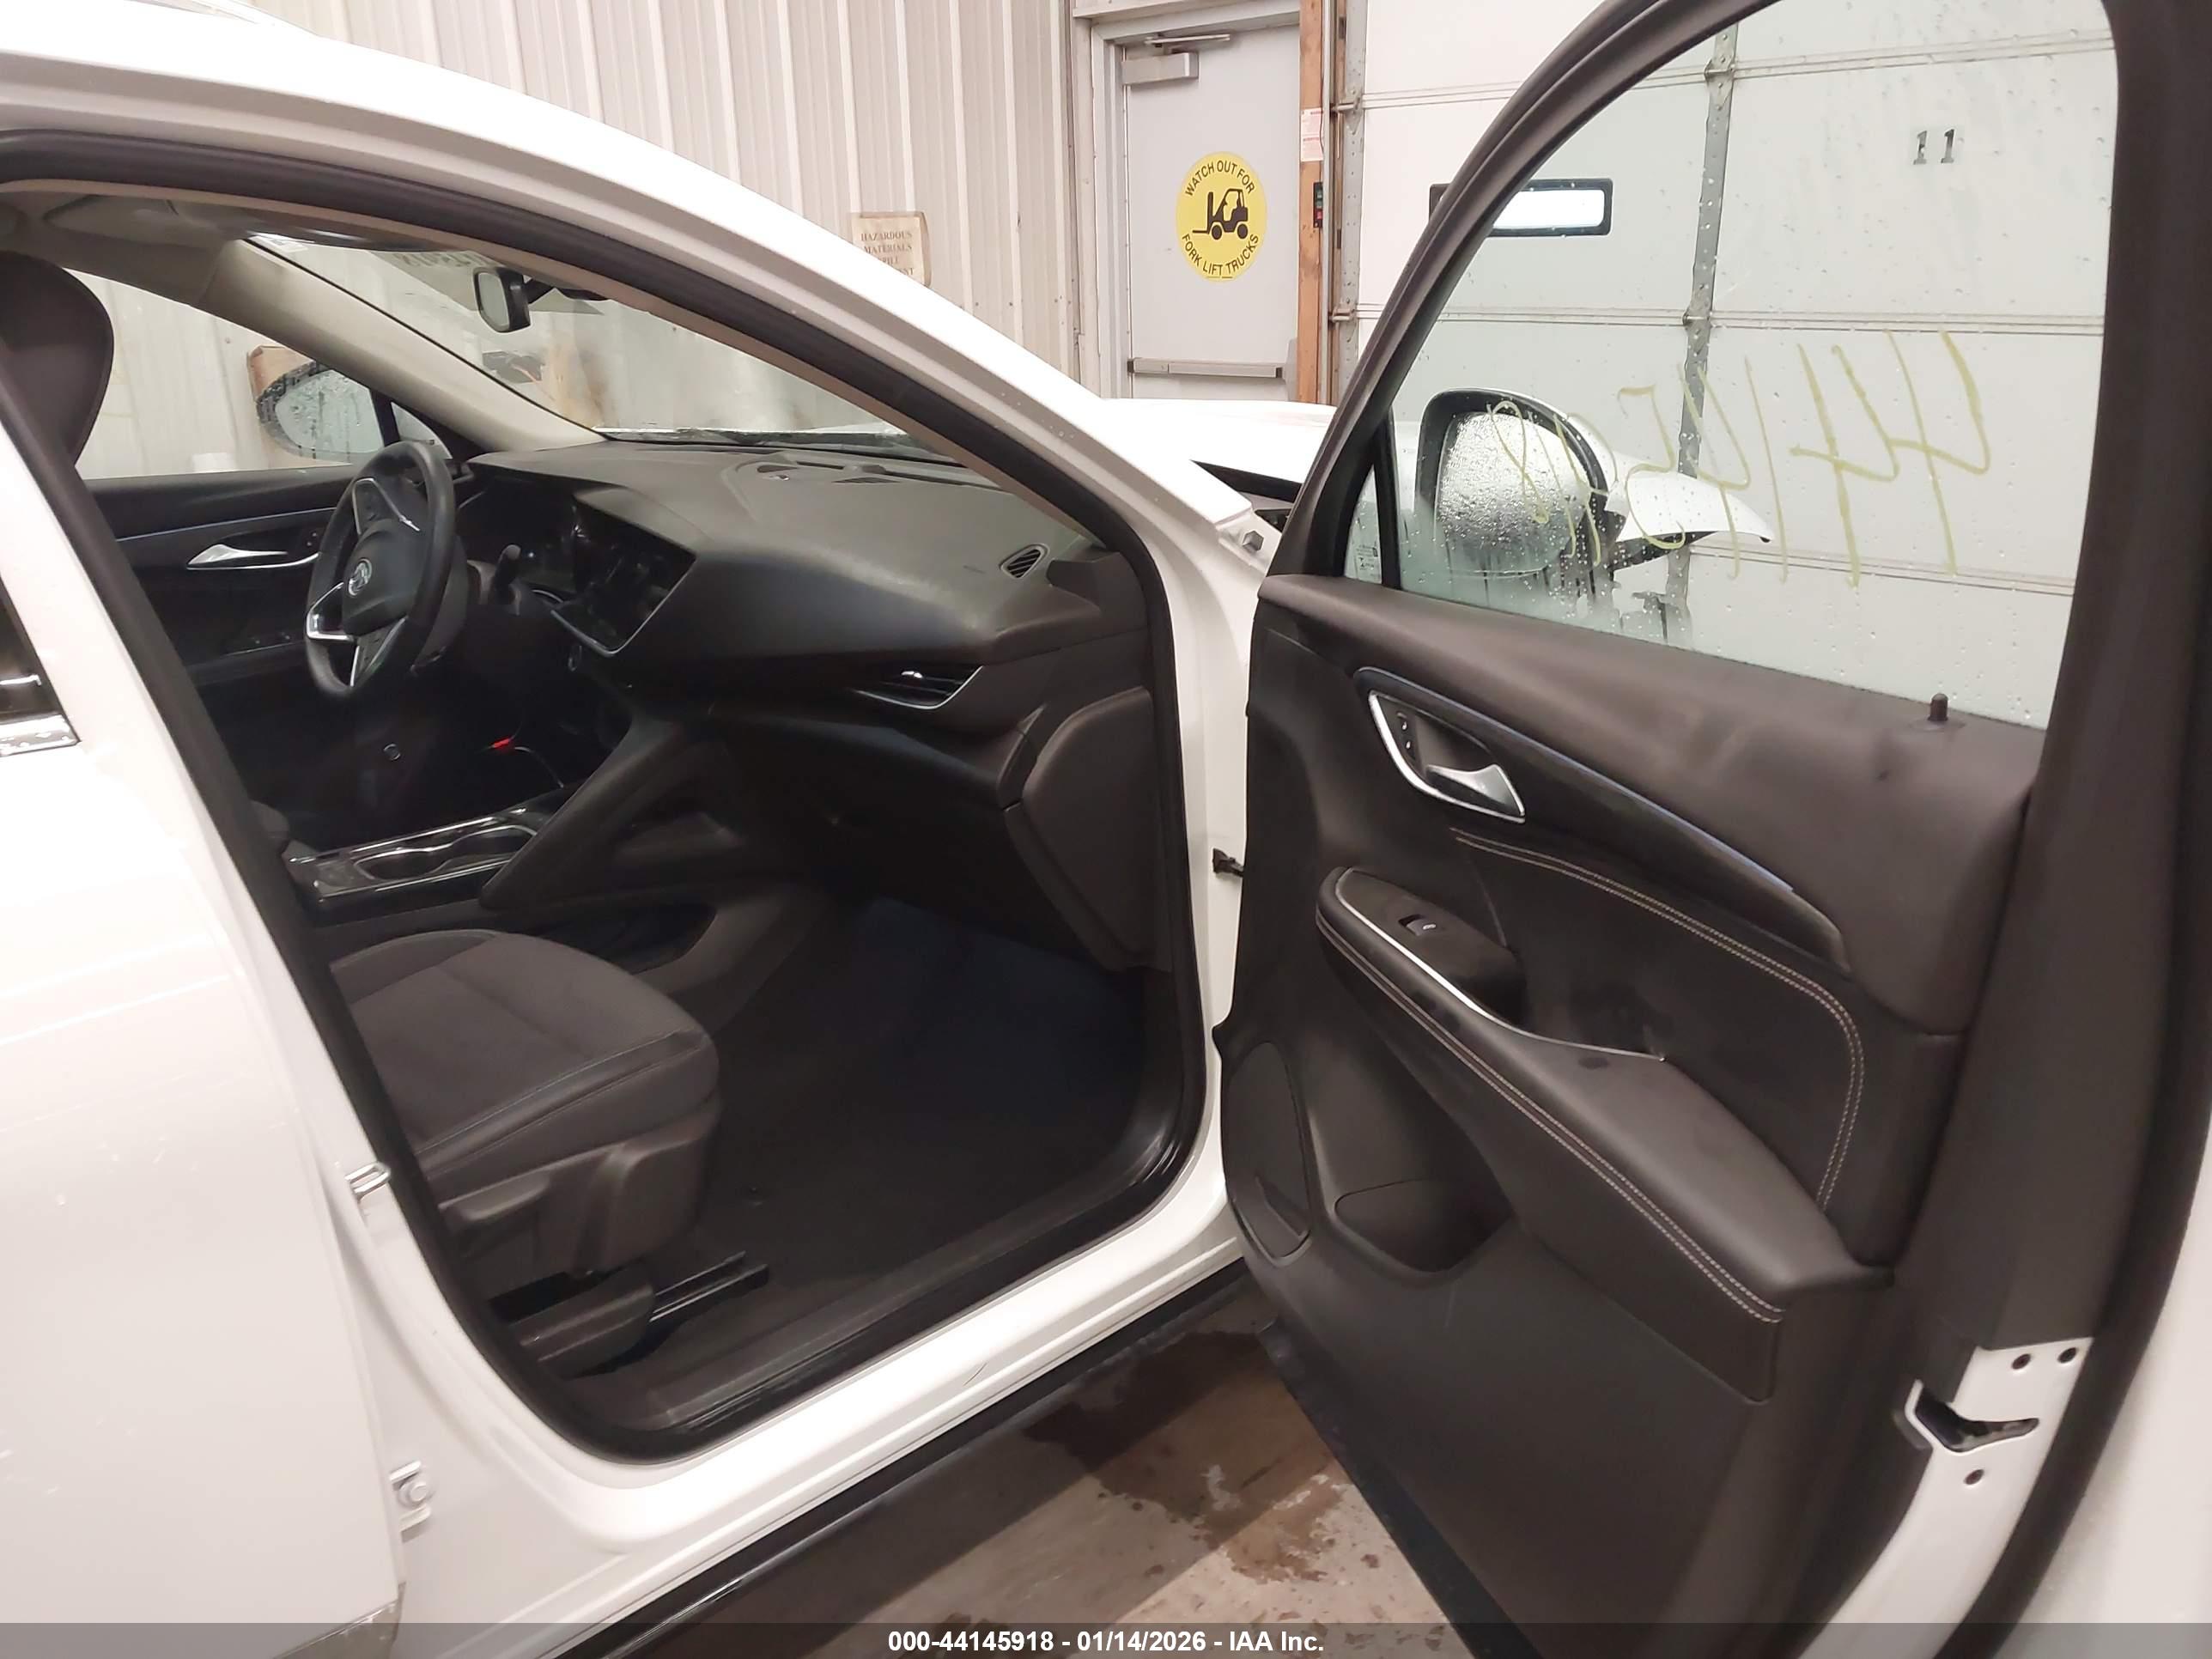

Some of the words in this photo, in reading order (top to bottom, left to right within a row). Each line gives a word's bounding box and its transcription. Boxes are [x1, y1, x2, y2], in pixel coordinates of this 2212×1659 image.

[1913, 129, 1954, 165] 11
[1185, 161, 1214, 196] WATCH
[1217, 160, 1237, 175] OUT
[1237, 168, 1255, 194] FOR
[860, 230, 913, 241] HAZARDOUS
[864, 244, 913, 254] MATERIALS
[1182, 234, 1203, 266] FORK
[1202, 260, 1223, 276] LIFT
[1225, 234, 1259, 275] TRUCKS
